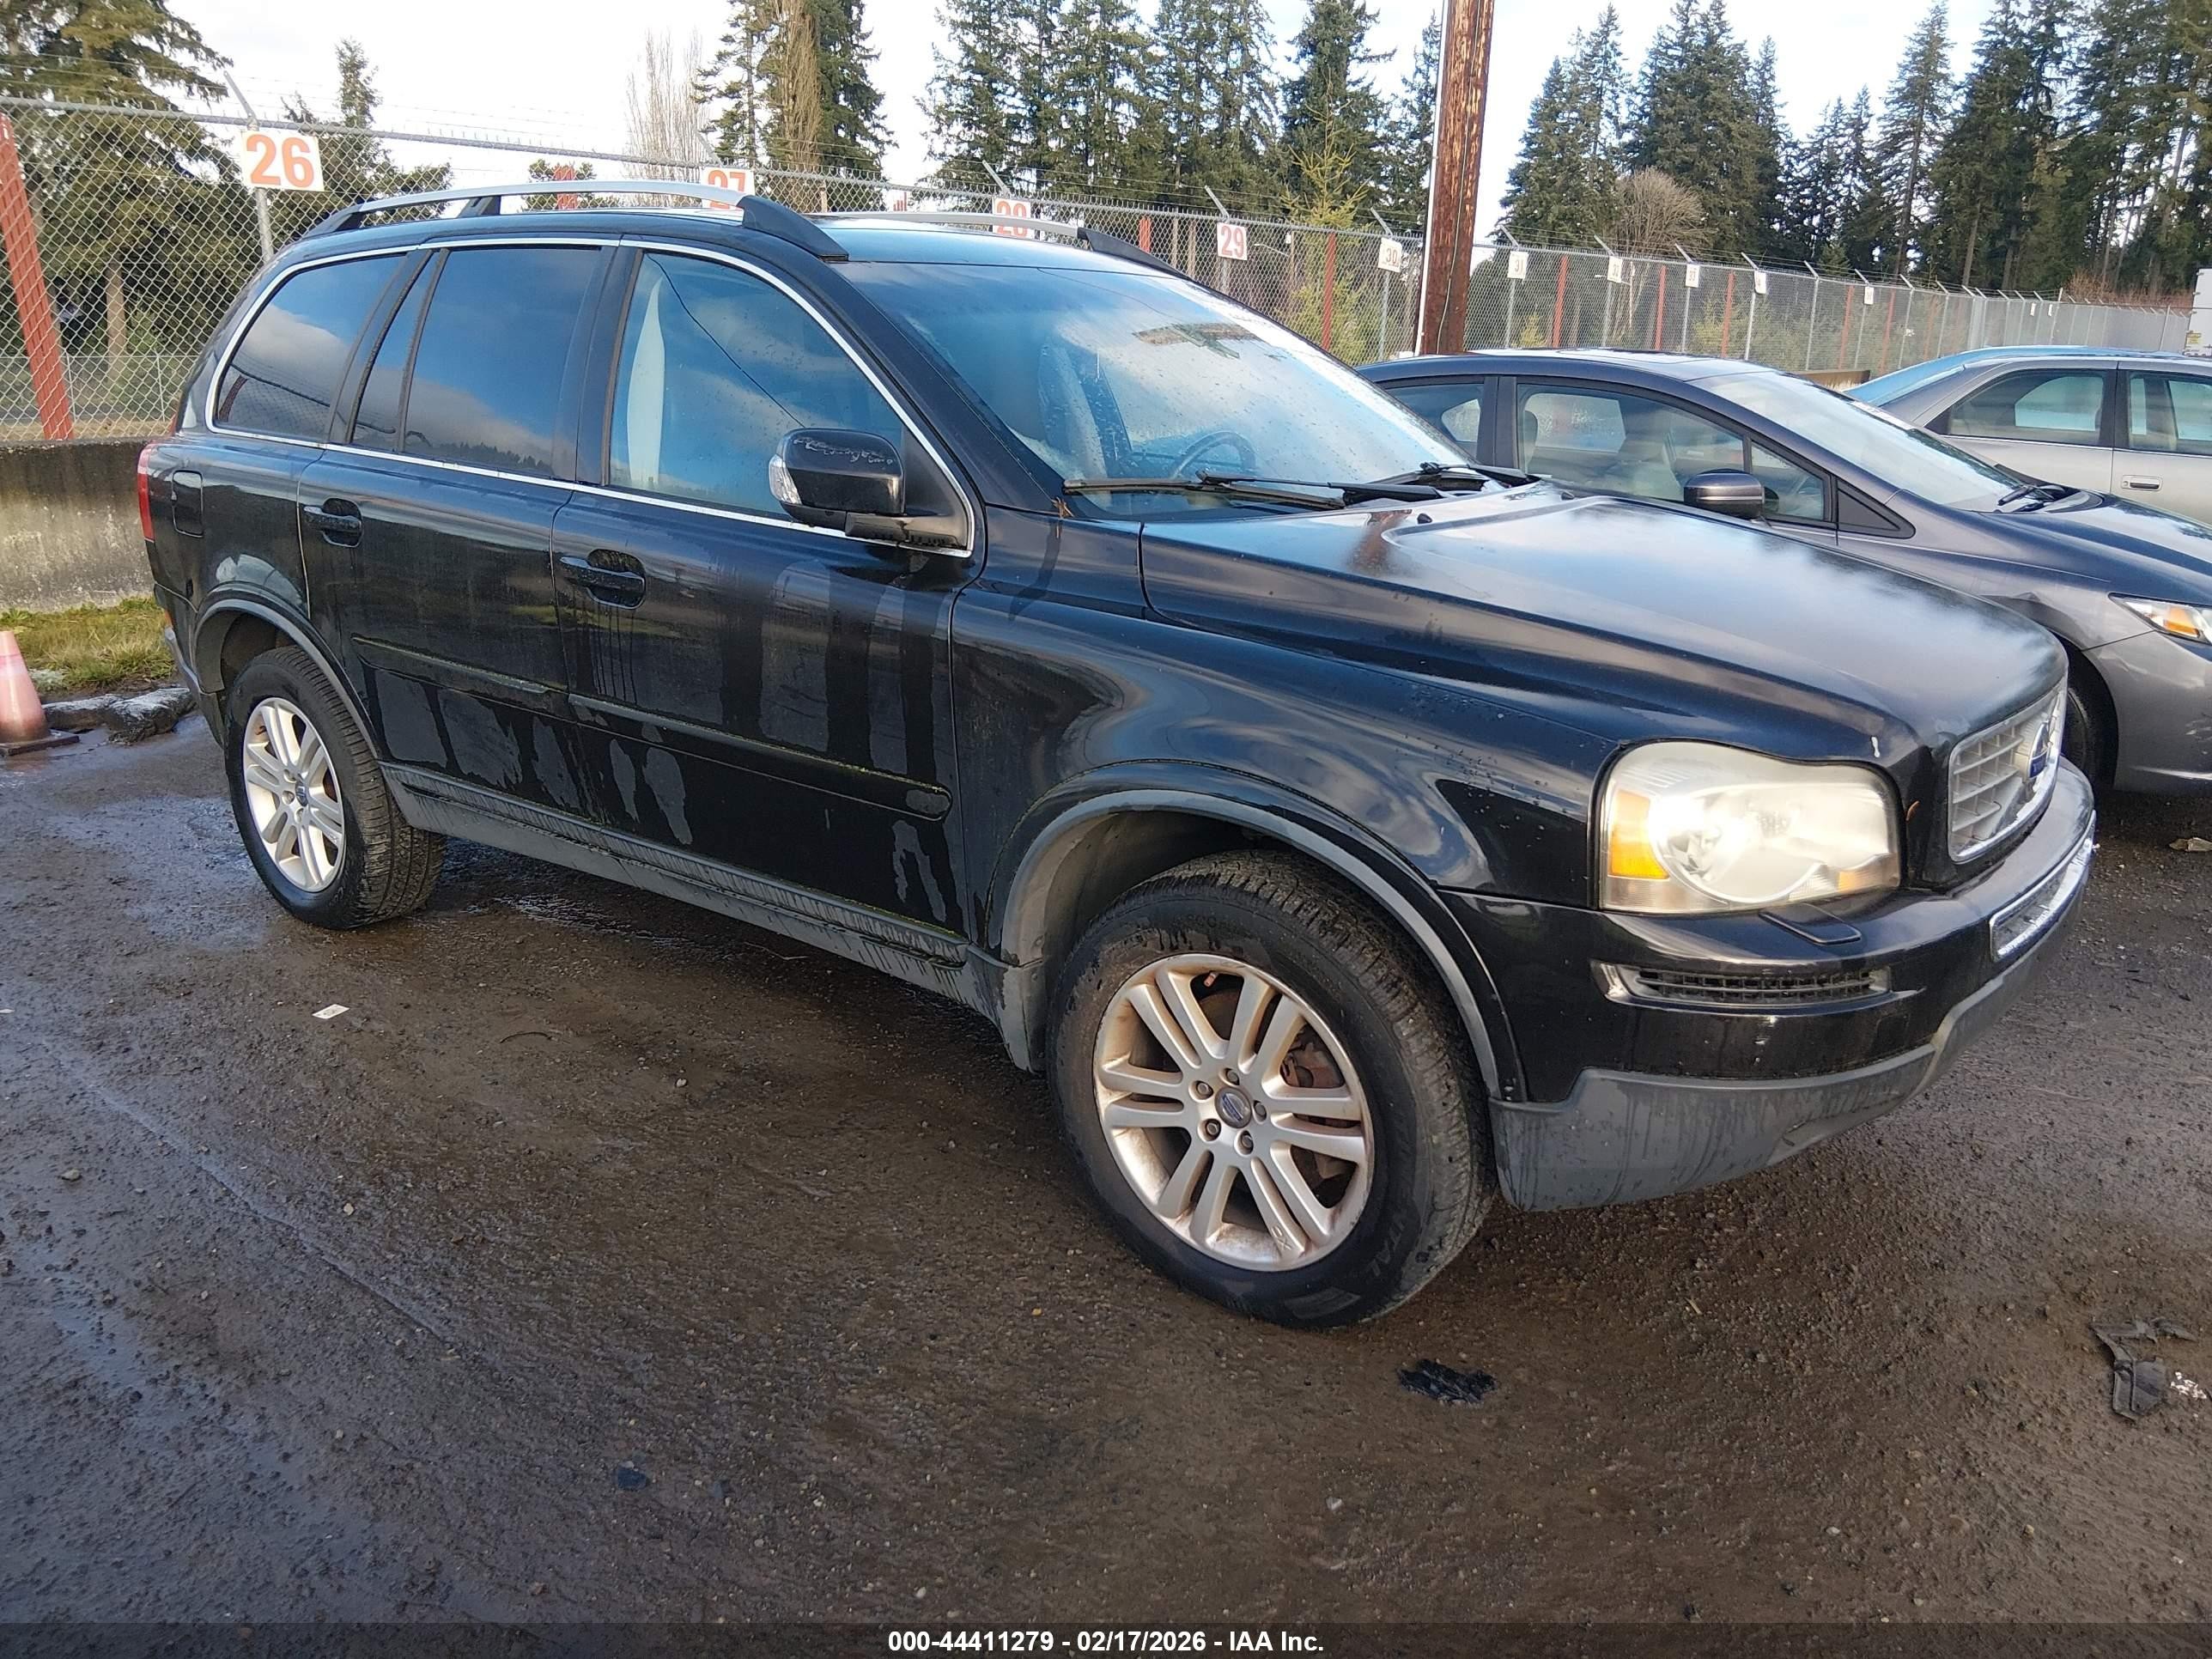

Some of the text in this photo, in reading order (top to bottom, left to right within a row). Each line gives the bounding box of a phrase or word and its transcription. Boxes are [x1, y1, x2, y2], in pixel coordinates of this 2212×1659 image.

[246, 134, 314, 188] 26
[708, 169, 745, 211] 27
[1220, 225, 1244, 258] 29
[1386, 247, 1398, 264] 30
